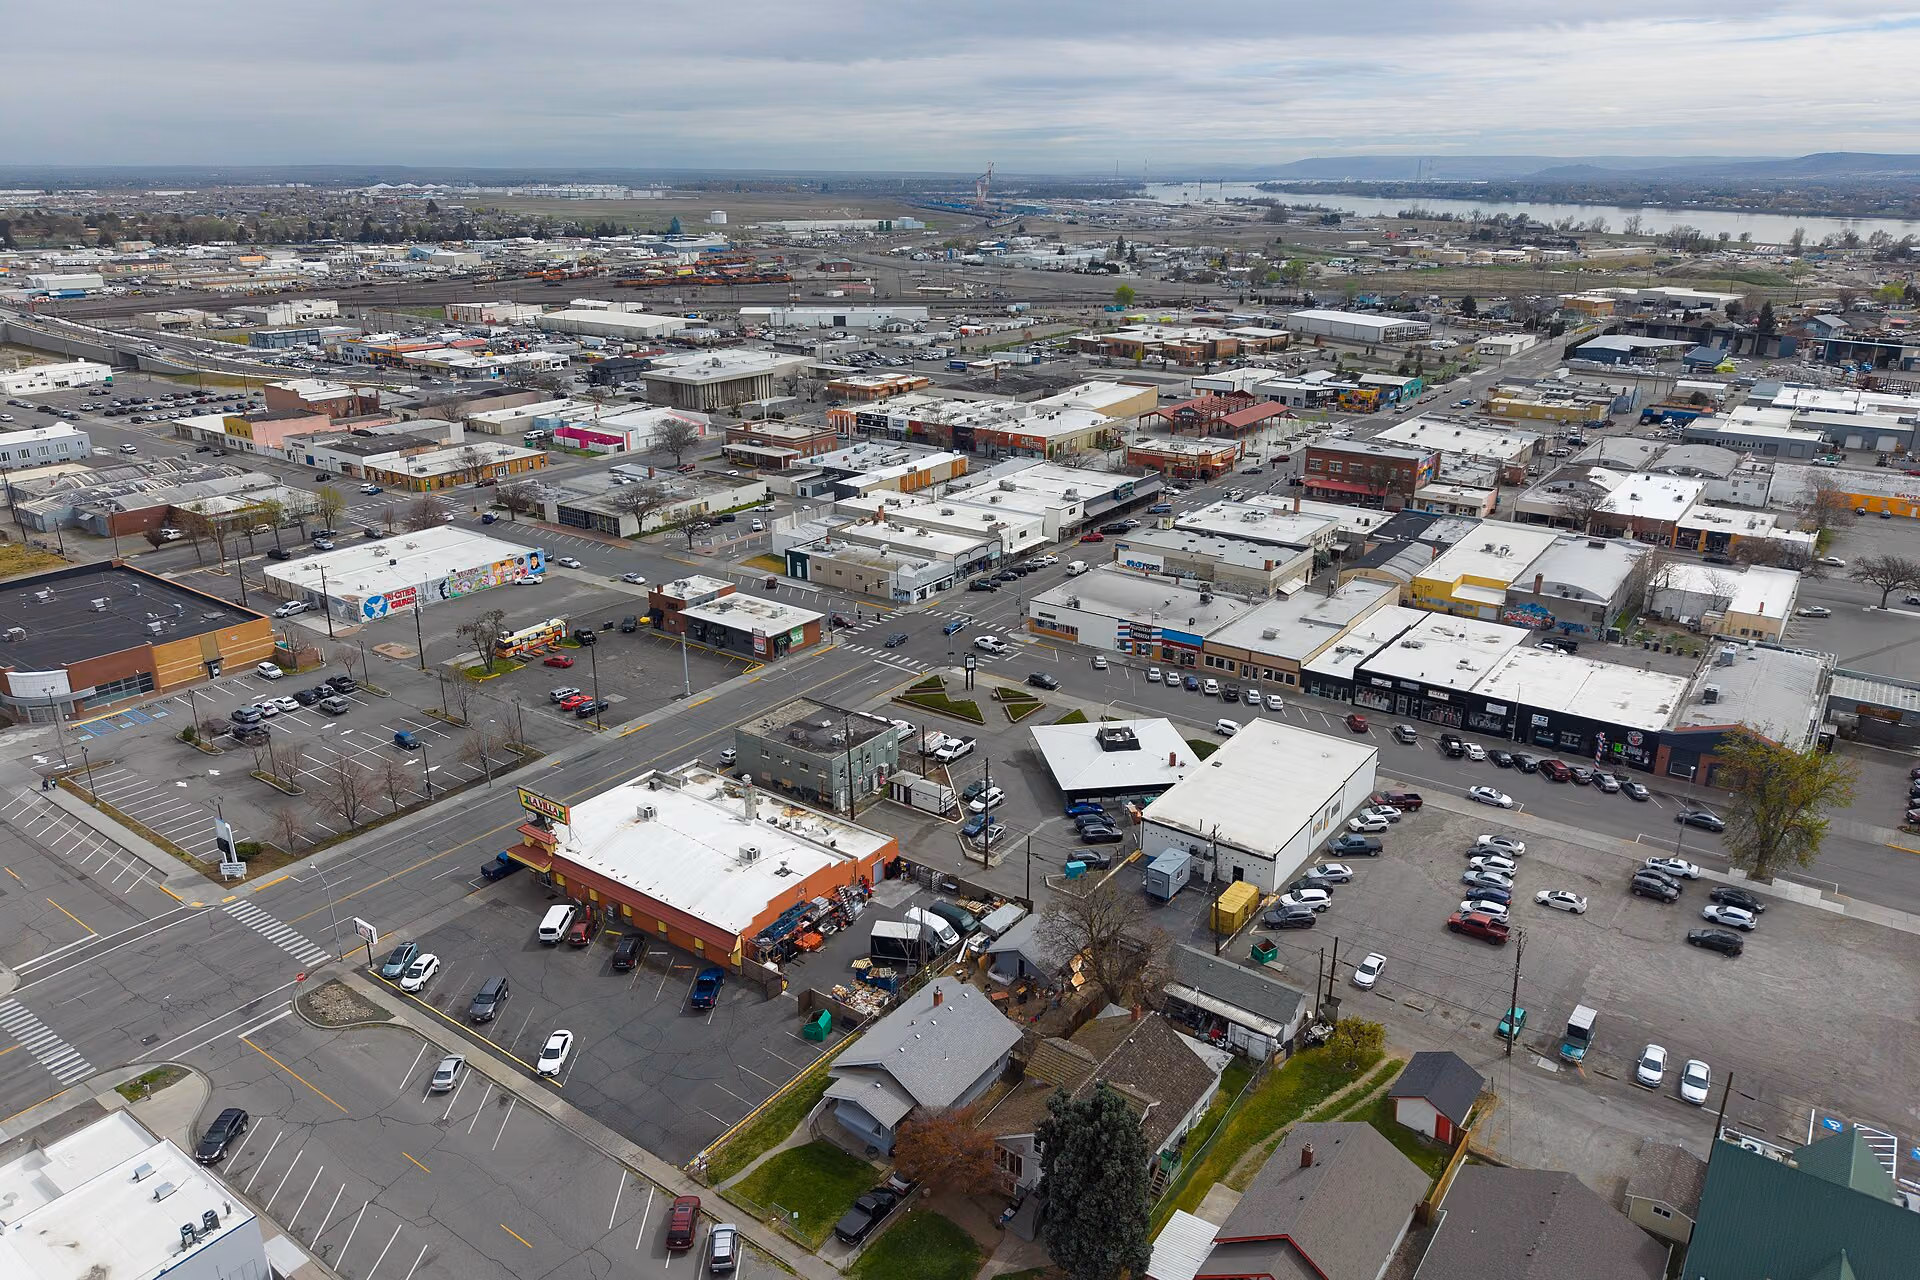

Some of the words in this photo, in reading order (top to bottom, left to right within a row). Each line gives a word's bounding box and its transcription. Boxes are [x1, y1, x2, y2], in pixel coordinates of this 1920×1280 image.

[383, 586, 417, 601] TRI-CITIES
[792, 632, 803, 643] TAX
[527, 795, 541, 809] LA
[539, 799, 559, 816] VILLA
